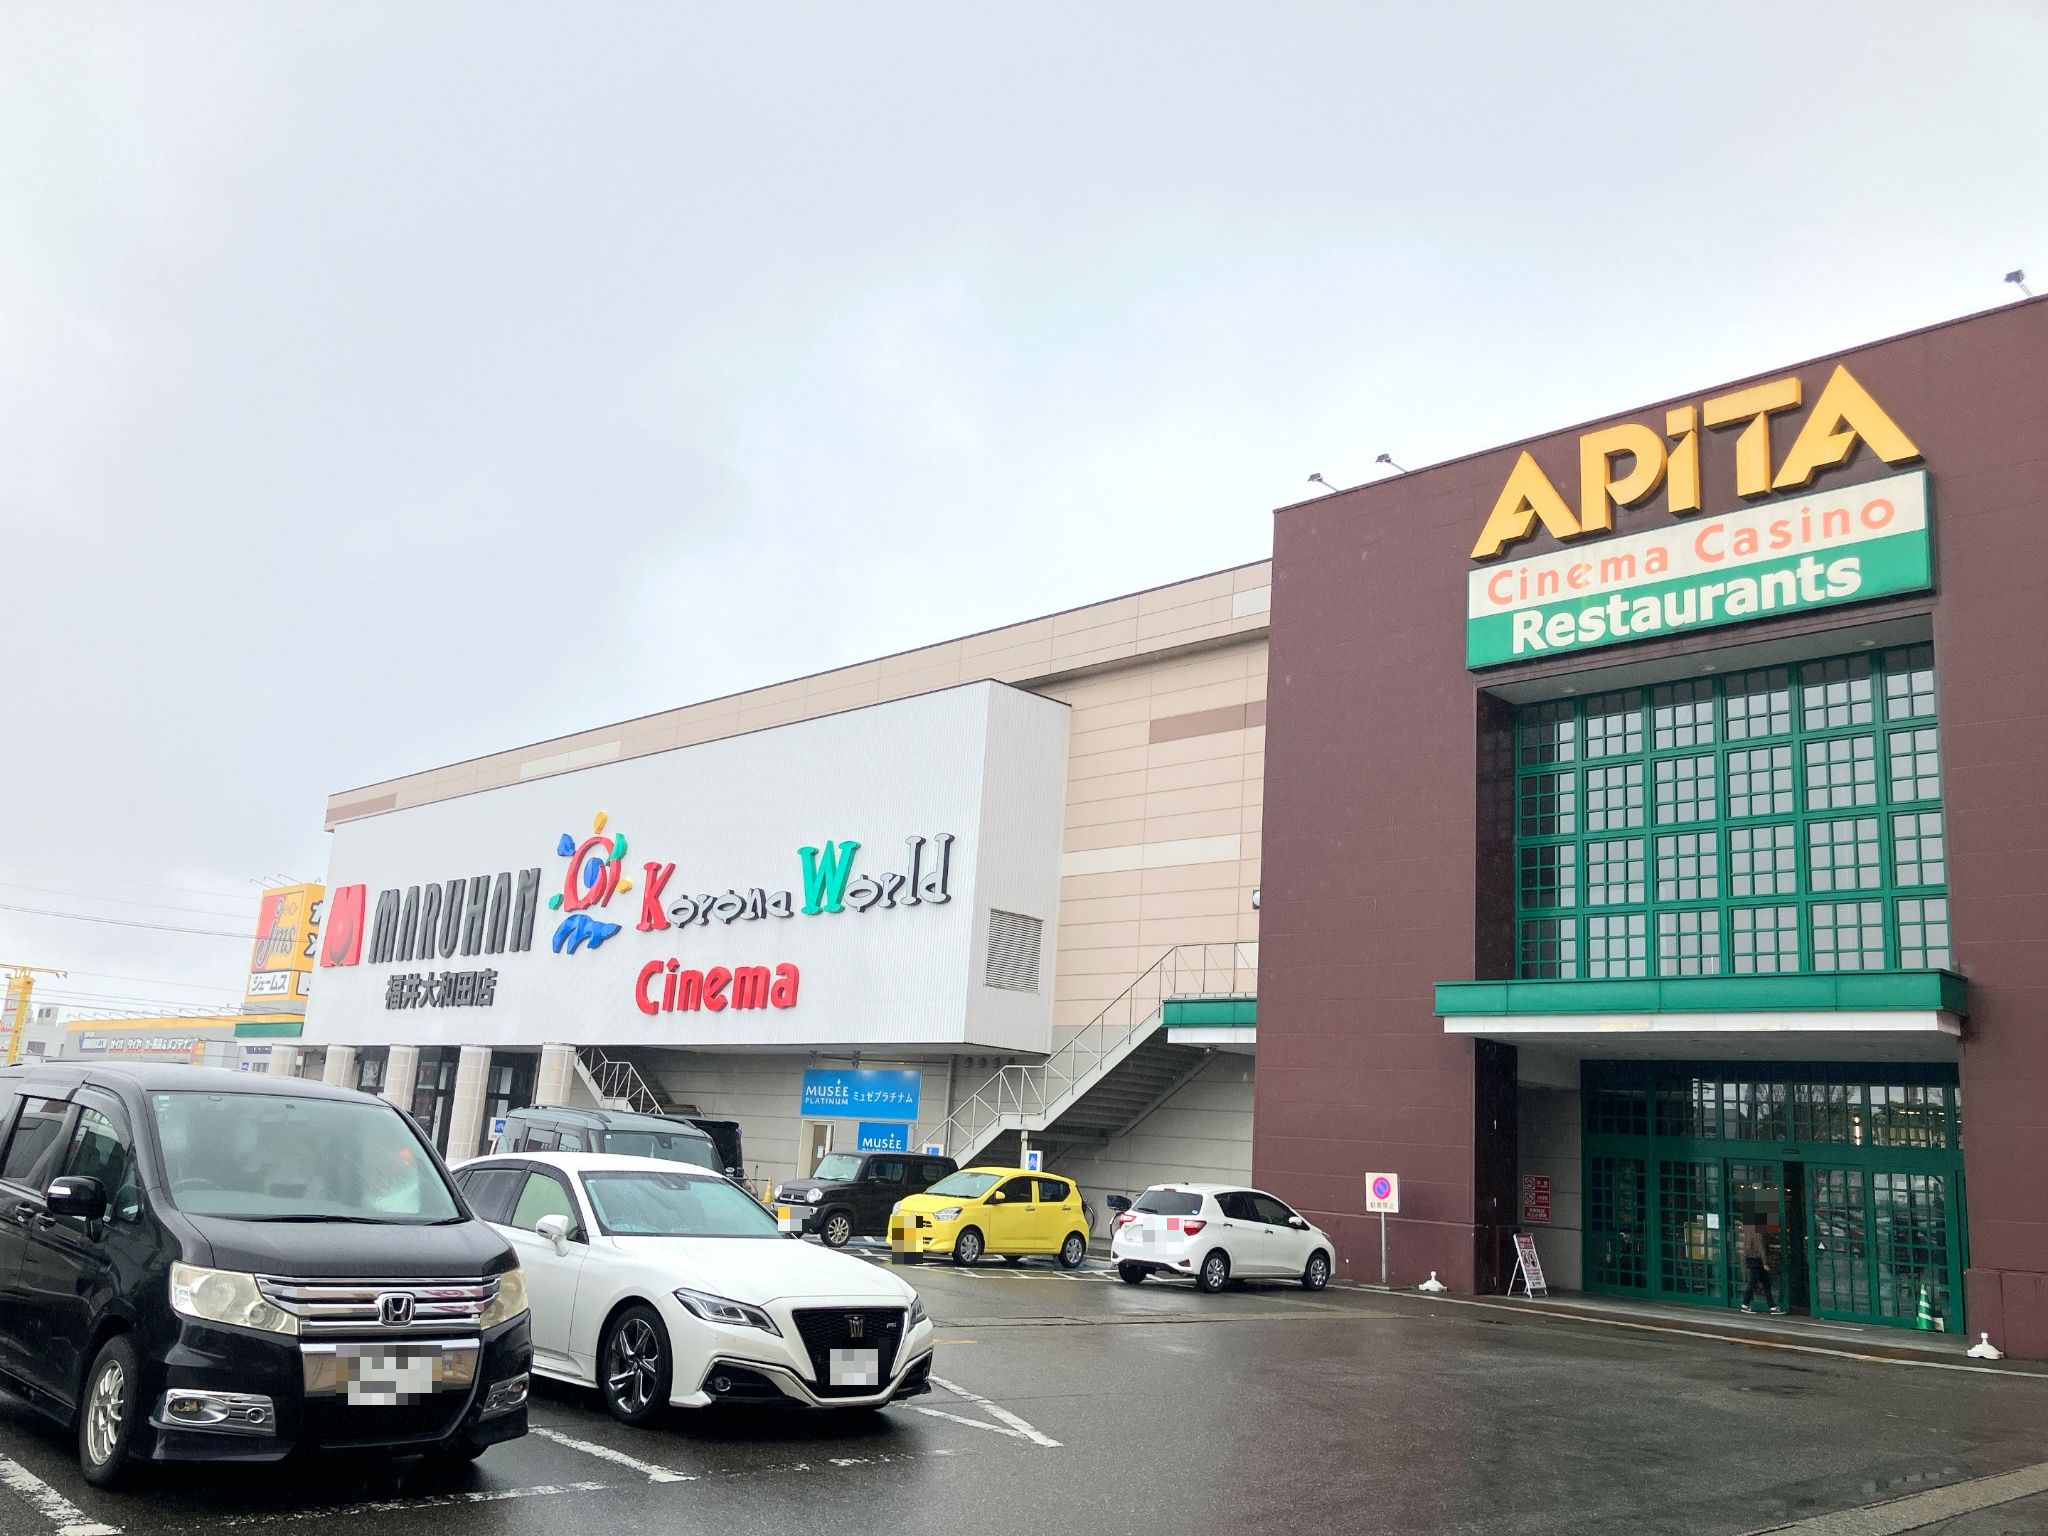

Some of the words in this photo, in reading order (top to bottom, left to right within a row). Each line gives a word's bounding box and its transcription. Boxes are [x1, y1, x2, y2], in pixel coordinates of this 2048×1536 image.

[1487, 541, 1669, 606] Cinema
[1695, 497, 1895, 564] Casino
[1512, 556, 1862, 654] Restaurants
[636, 862, 795, 932] Korona
[798, 832, 955, 915] World
[368, 868, 542, 964] MARUHAN
[251, 974, 288, 992] ジェームス
[385, 968, 498, 1010] 福井大和田店
[636, 958, 800, 1015] Cinema
[804, 1097, 849, 1105] PLATINUM
[853, 1091, 913, 1103] ミュゼプラチナム
